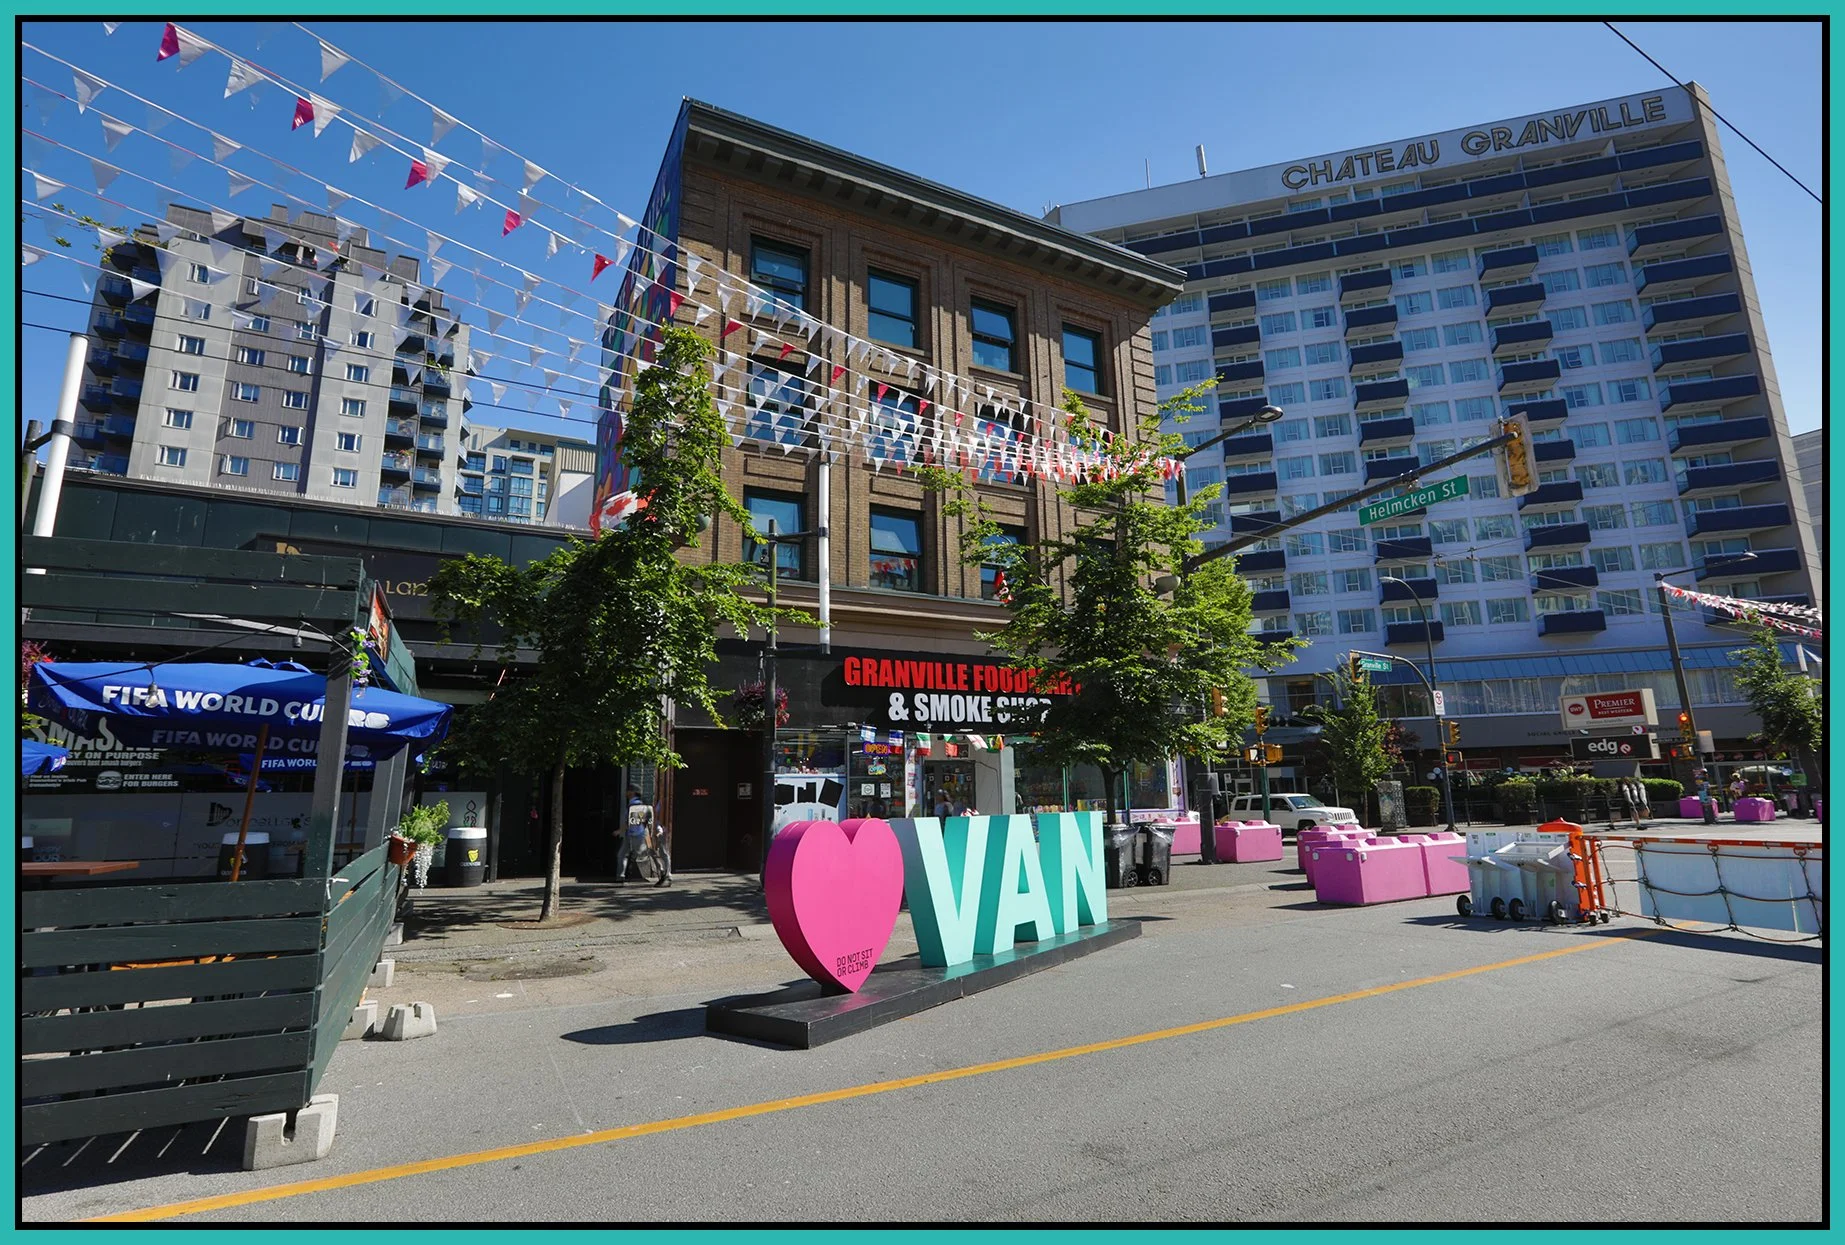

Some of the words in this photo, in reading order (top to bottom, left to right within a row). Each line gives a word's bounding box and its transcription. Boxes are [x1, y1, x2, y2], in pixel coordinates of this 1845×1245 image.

[1282, 139, 1440, 190] CHATEAU
[1460, 96, 1667, 156] GRANVILLE
[1369, 490, 1436, 520] Helmcken
[1442, 481, 1457, 497] St
[844, 656, 968, 692] GRANVILLE
[973, 664, 1081, 696] FOODAR
[102, 685, 169, 709] FIFA
[175, 690, 279, 717] WORLD
[888, 692, 910, 722] &
[914, 693, 992, 723] SMOKE
[1594, 698, 1635, 709] PREMIER
[28, 716, 169, 751] SMAS
[152, 729, 200, 746] FIFA
[85, 752, 101, 760] ON
[105, 752, 160, 760] PURPOSE
[261, 759, 285, 769] FIFA
[286, 757, 317, 768] WORL
[902, 812, 1108, 966] VAN
[837, 956, 846, 967] DO
[847, 952, 860, 964] NOT
[861, 948, 873, 960] SIT
[837, 966, 846, 978] OR
[848, 960, 869, 974] CLIMB
